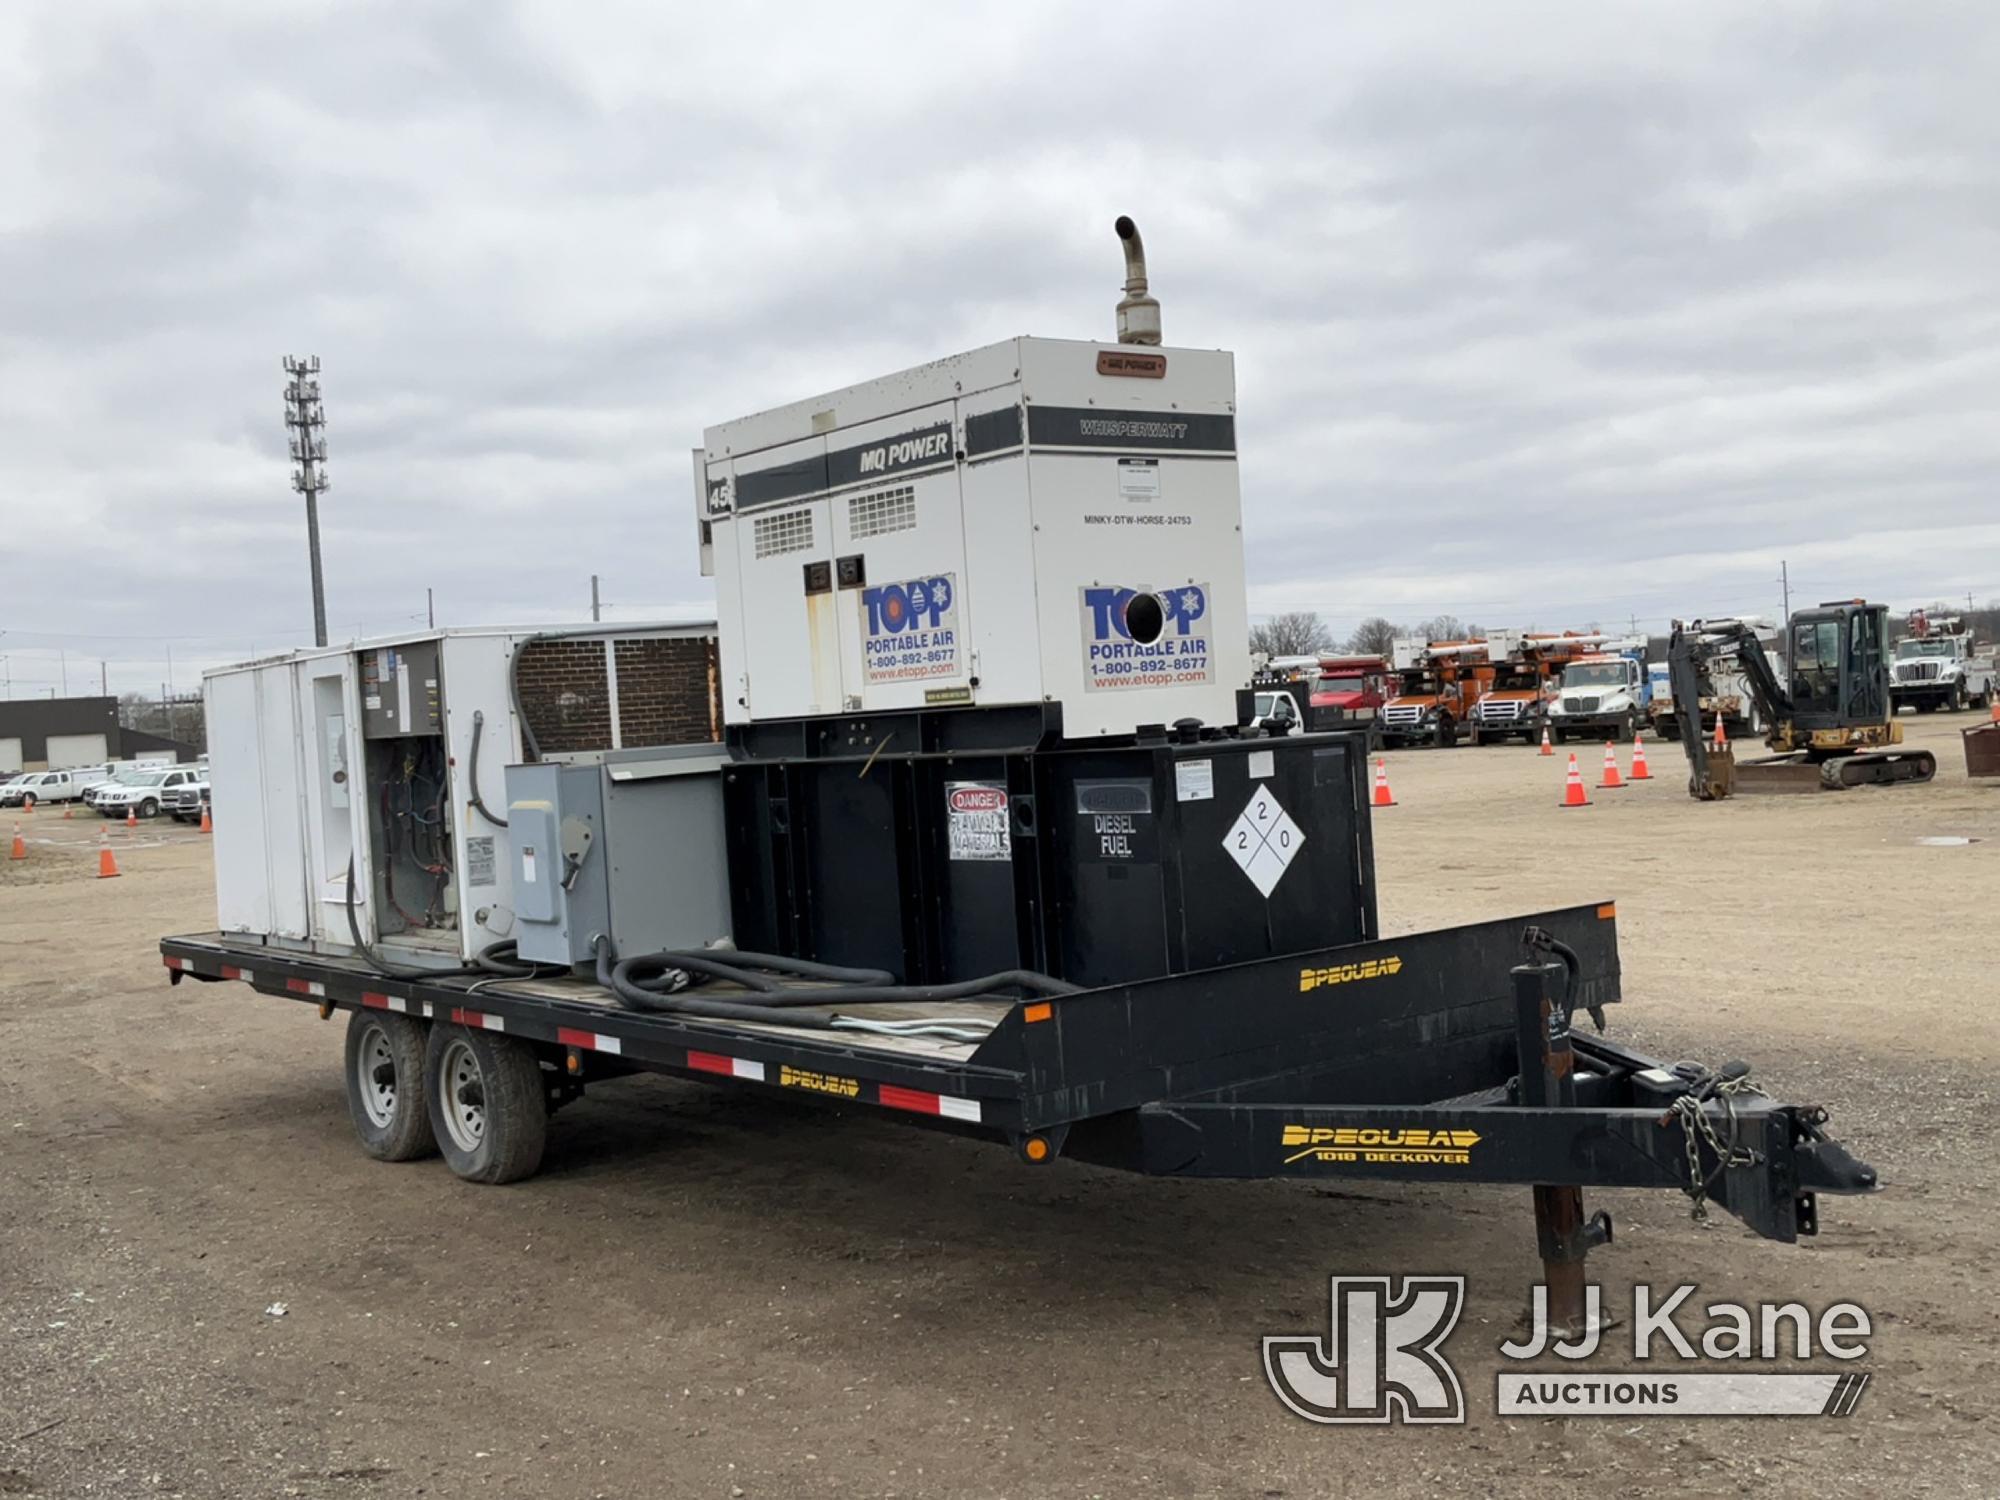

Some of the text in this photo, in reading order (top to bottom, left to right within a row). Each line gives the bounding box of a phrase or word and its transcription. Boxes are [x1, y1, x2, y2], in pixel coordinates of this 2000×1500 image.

[1080, 419, 1188, 439] WHISPERWATT
[860, 432, 948, 472] MQ POWER
[1084, 514, 1192, 526] MINKY-DTW-HORSE-24753
[862, 577, 952, 636] TOPP
[866, 631, 954, 655] PORTABLE AIR
[1090, 639, 1206, 660] PORTABLE AIR
[867, 649, 954, 669] 1-800-892-8677
[1090, 657, 1207, 675] 1-800-892-8677
[870, 662, 954, 680] www.etopp.com
[1094, 670, 1206, 688] www.etopp.com
[956, 792, 1000, 808] DANGER
[1257, 801, 1268, 820] 2
[1094, 814, 1137, 834] DIESEL
[1101, 835, 1132, 854] FUEL
[1238, 830, 1290, 850] 2 0
[1365, 1152, 1470, 1163] DECKOVER
